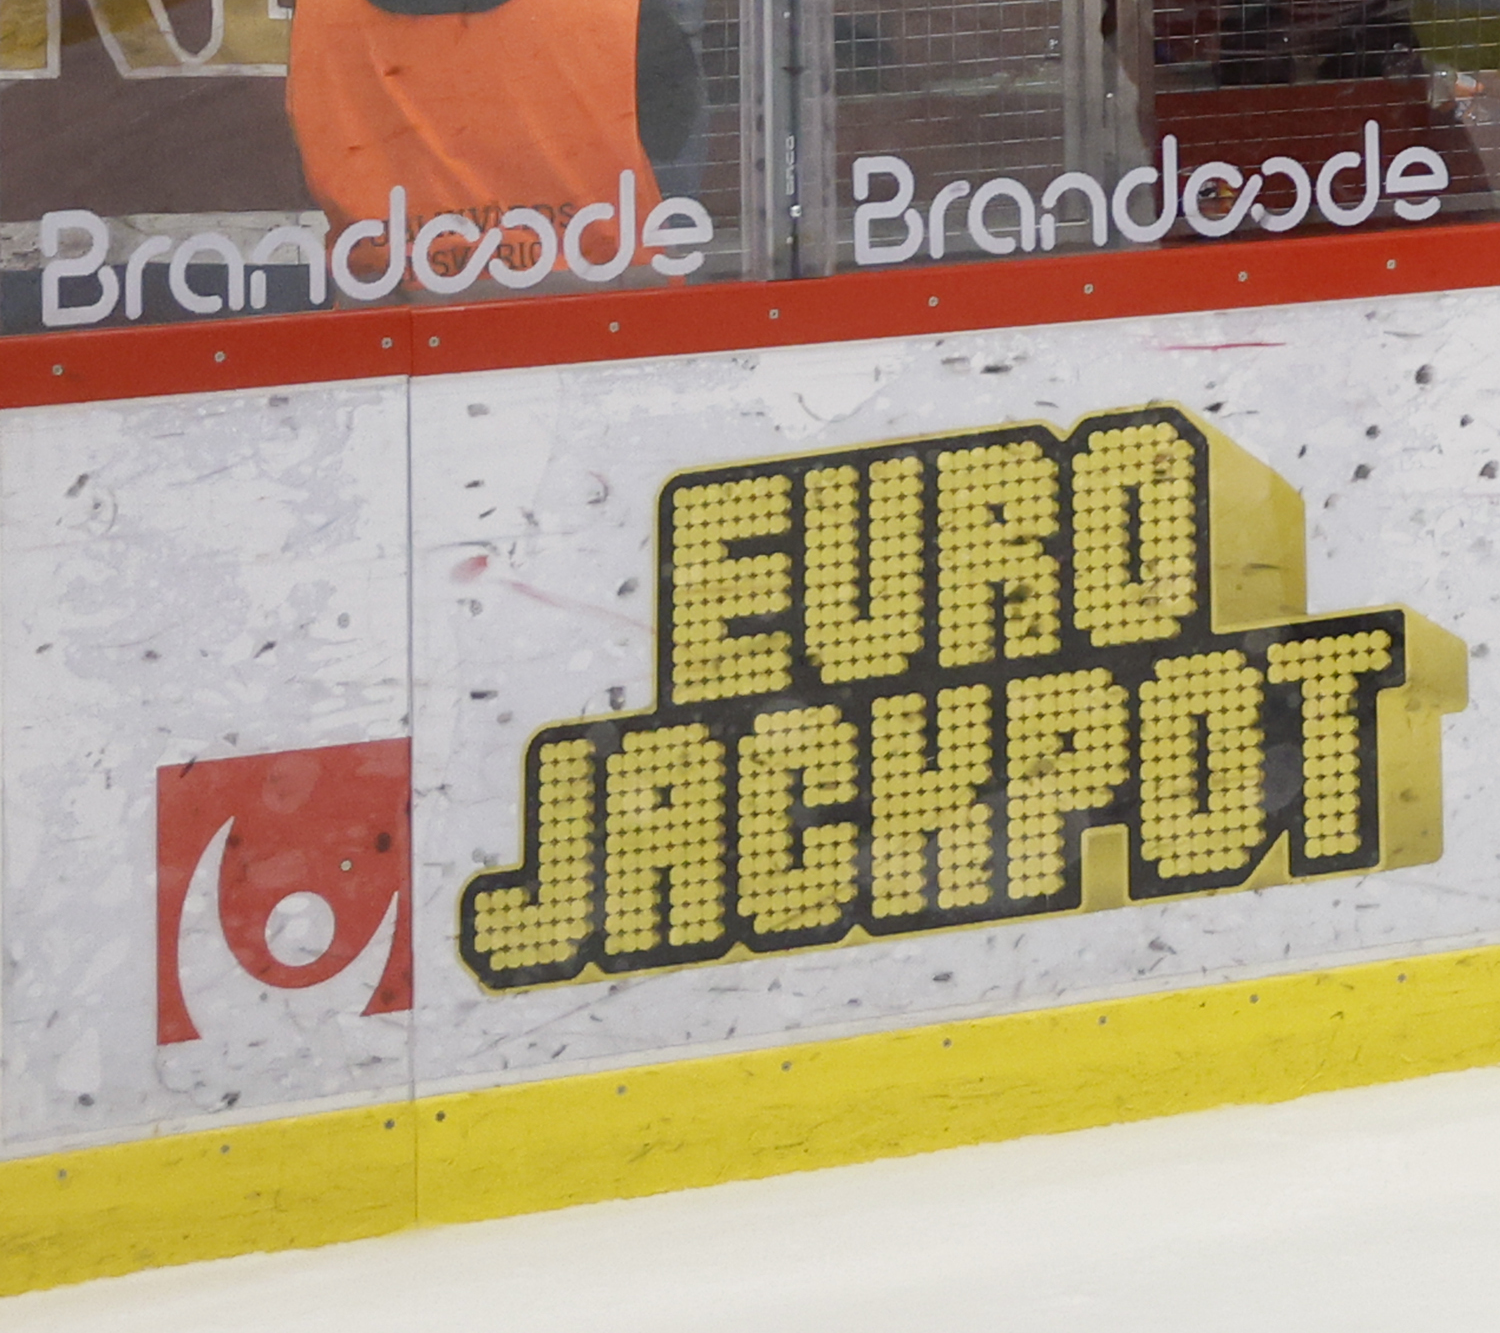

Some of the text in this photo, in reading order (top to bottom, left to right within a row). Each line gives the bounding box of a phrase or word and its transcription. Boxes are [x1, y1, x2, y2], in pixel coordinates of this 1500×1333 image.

[43, 170, 714, 328] Brandcode
[855, 122, 1450, 265] Brandcode
[667, 417, 1202, 707] EURO
[467, 623, 1396, 978] JACKPOT
